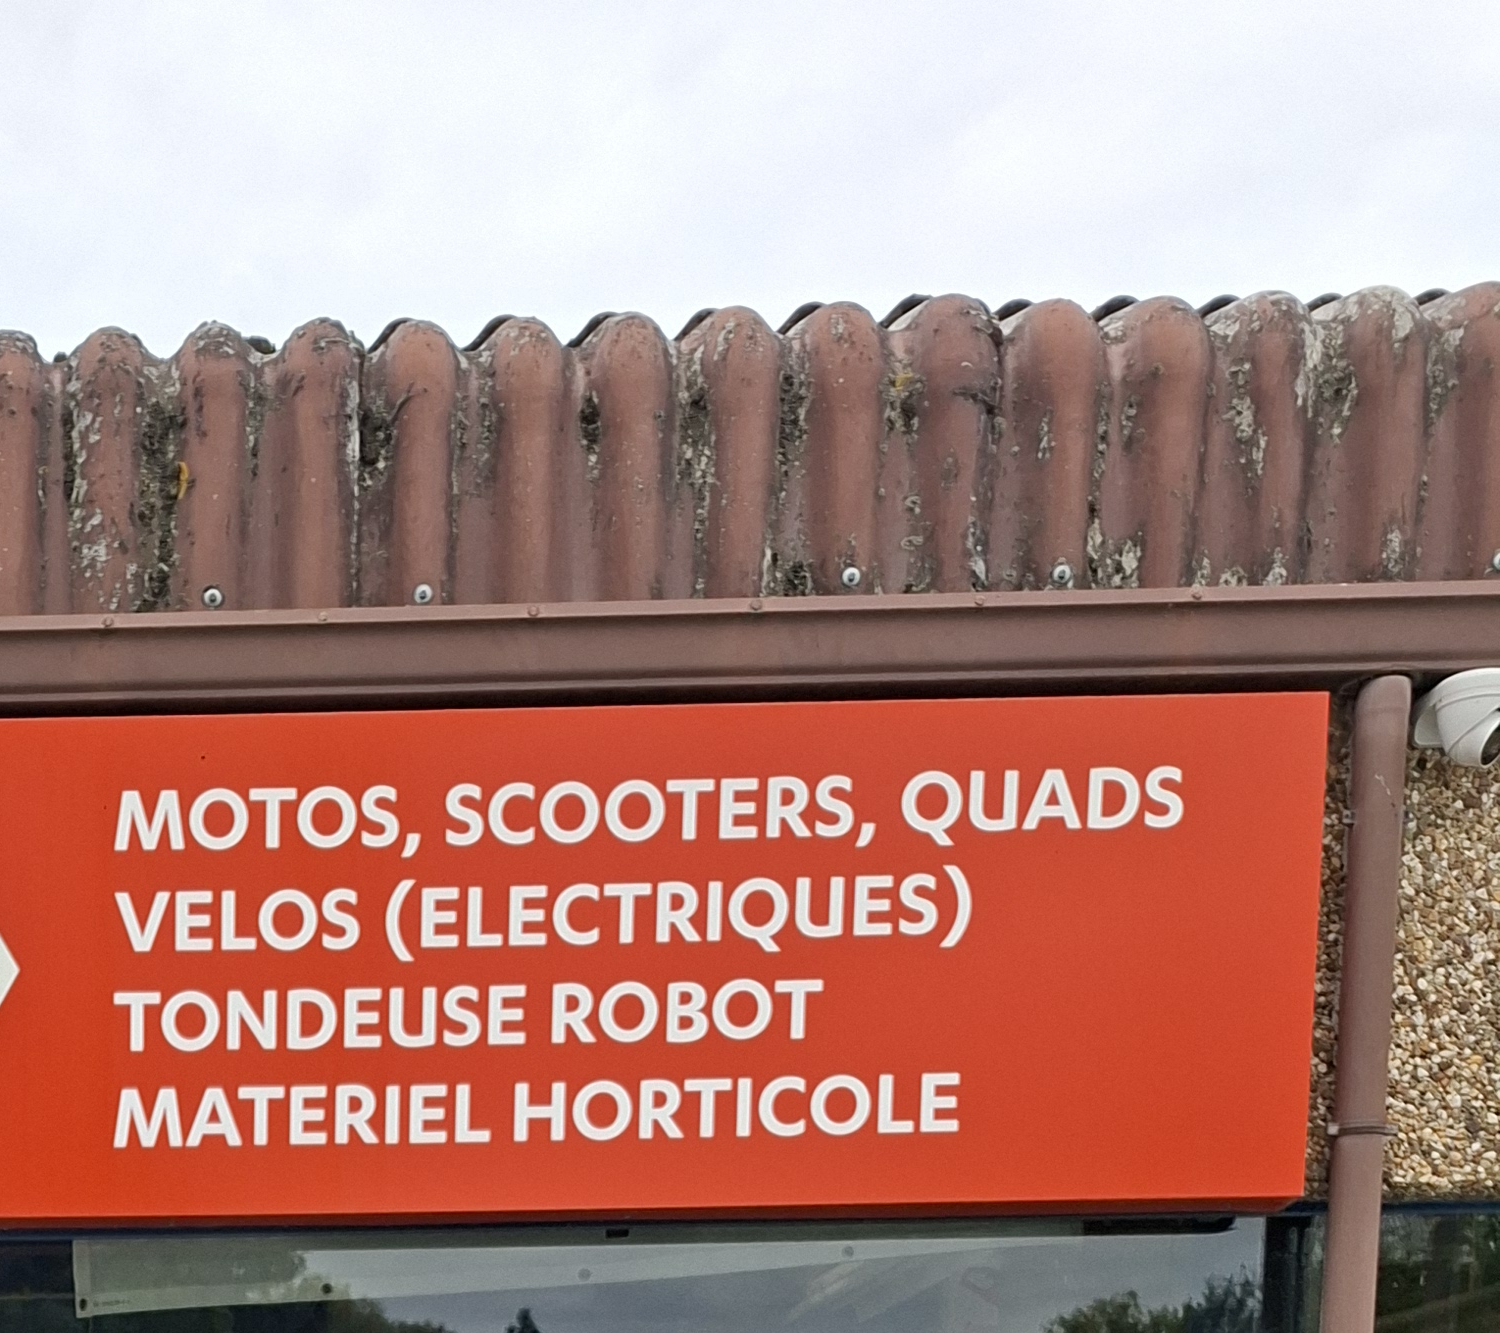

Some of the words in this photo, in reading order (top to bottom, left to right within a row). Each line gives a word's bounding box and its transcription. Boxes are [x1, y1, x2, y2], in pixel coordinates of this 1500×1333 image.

[113, 784, 421, 858] MOTOS,
[445, 774, 876, 848] SCOOTERS,
[901, 765, 1184, 847] QUADS
[114, 887, 361, 953] VELOS
[385, 864, 972, 962] (ELECTRIQUES)
[113, 984, 527, 1052] TONDEUSE
[550, 978, 824, 1045] ROBOT
[113, 1083, 492, 1149] MATERIEL
[513, 1071, 961, 1143] HORTICOLE
